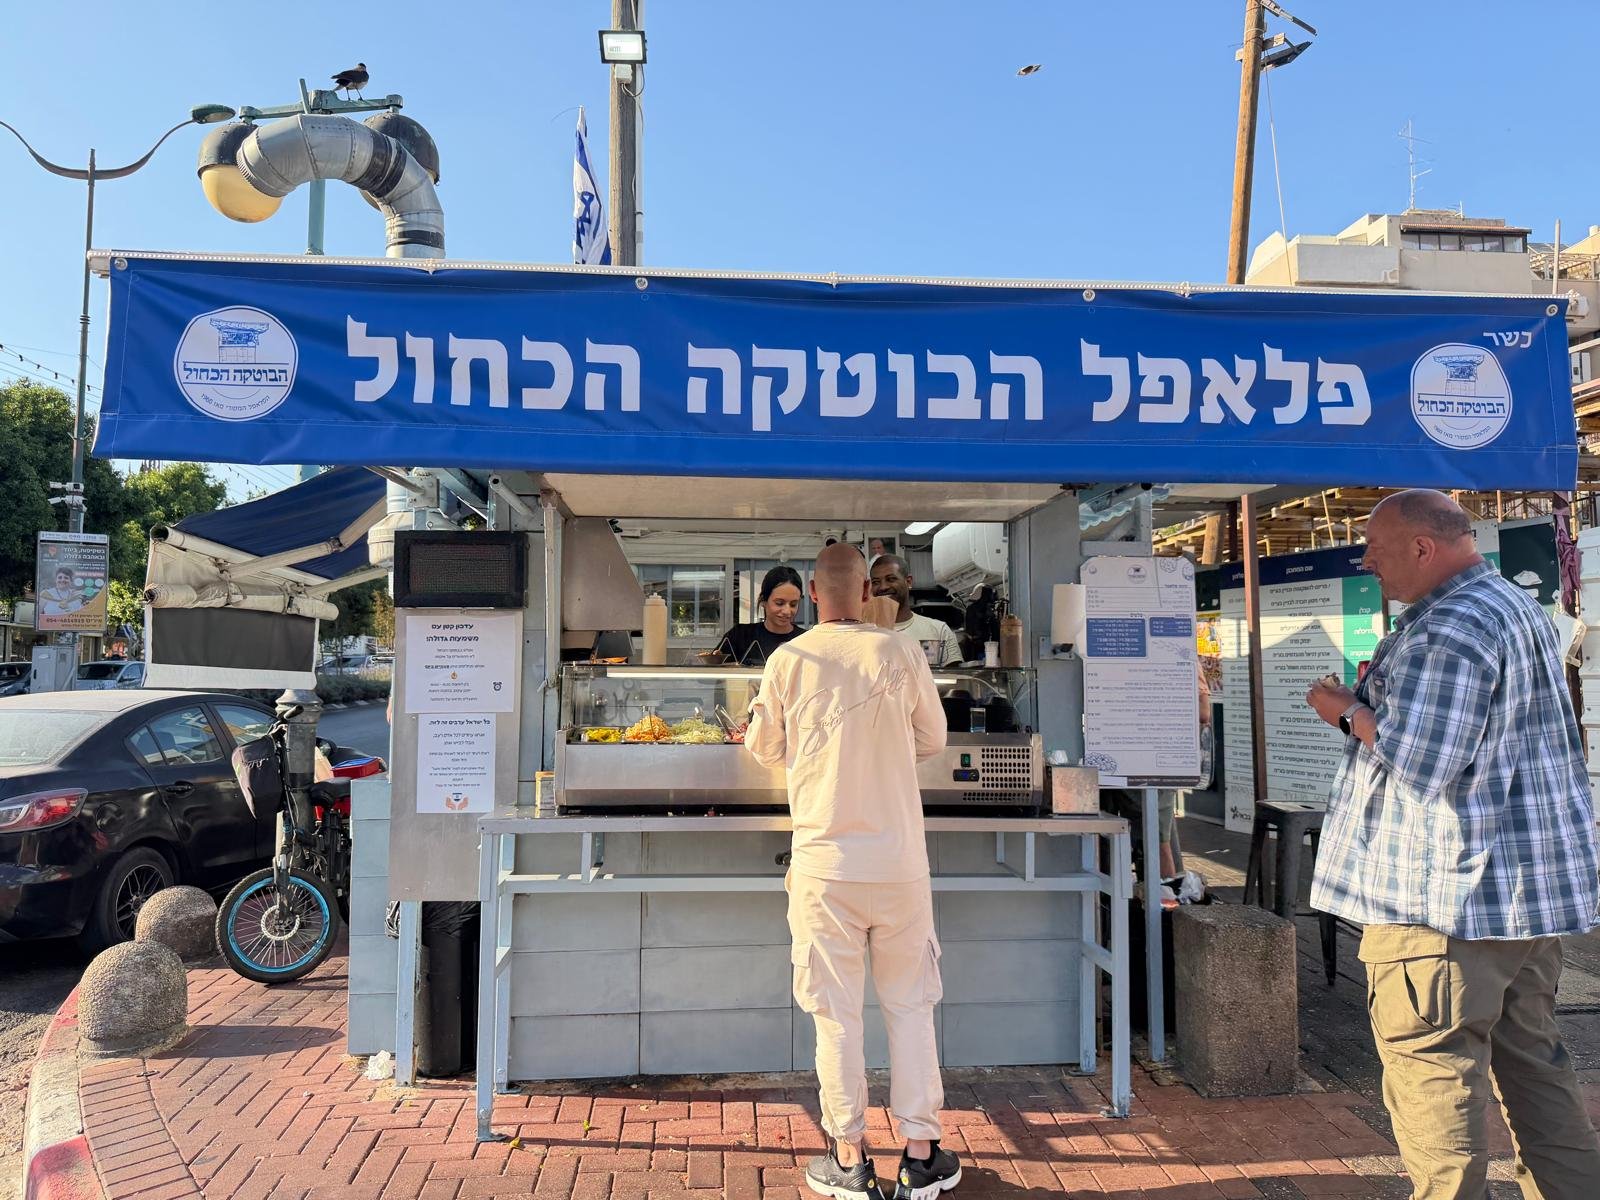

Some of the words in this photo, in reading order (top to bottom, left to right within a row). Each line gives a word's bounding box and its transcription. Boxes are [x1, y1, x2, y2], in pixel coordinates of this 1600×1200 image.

[1483, 331, 1532, 348] כשר
[346, 314, 642, 412] הכחול
[183, 363, 230, 382] הכחול
[233, 367, 288, 384] הבוטקה
[686, 341, 1044, 432] הבוטקה
[1080, 338, 1373, 426] פלאפל
[1417, 396, 1455, 413] הכחול
[1456, 401, 1506, 416] הבוטקה
